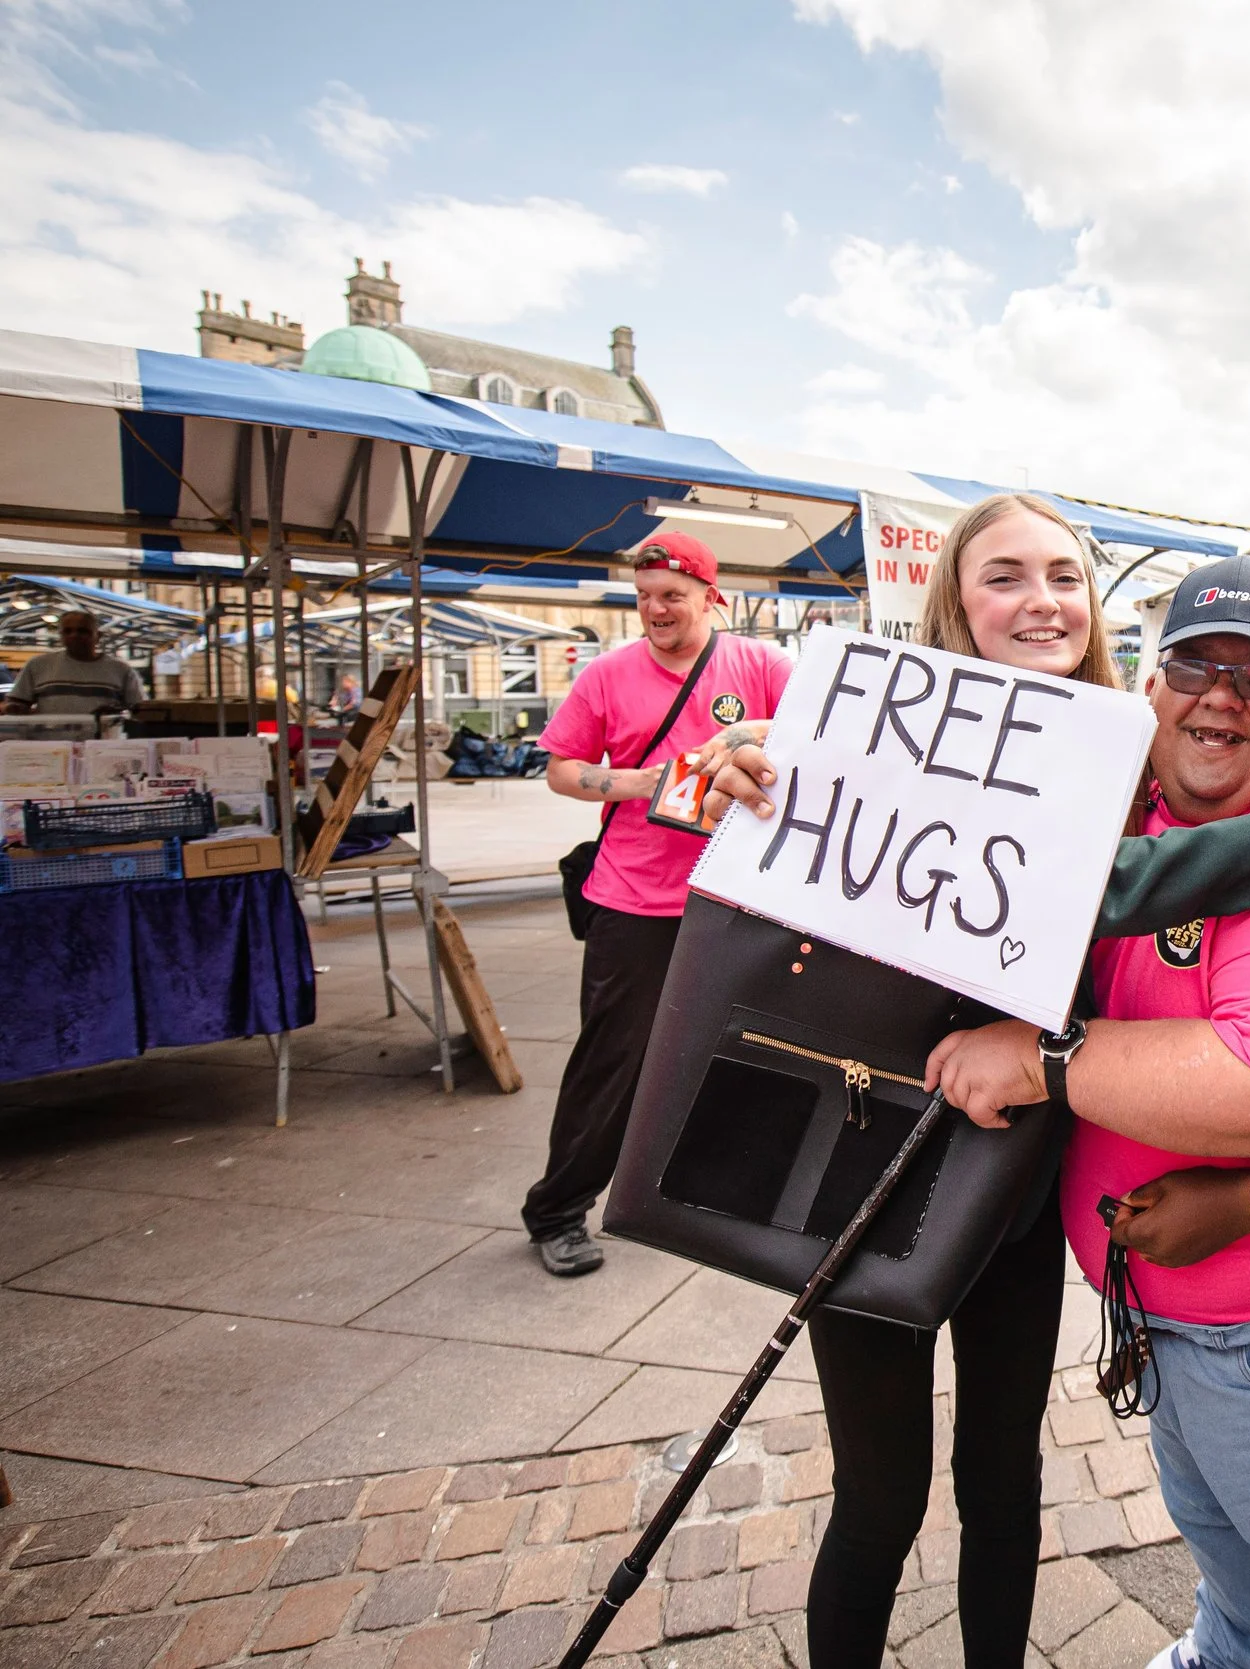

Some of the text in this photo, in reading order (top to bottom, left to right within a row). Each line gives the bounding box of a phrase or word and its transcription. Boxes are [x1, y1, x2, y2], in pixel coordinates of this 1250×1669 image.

[876, 559, 937, 585] IN W
[814, 641, 1075, 797] FREE
[664, 774, 699, 818] 4
[758, 766, 1025, 938] HUGS
[1166, 927, 1200, 949] FEST
